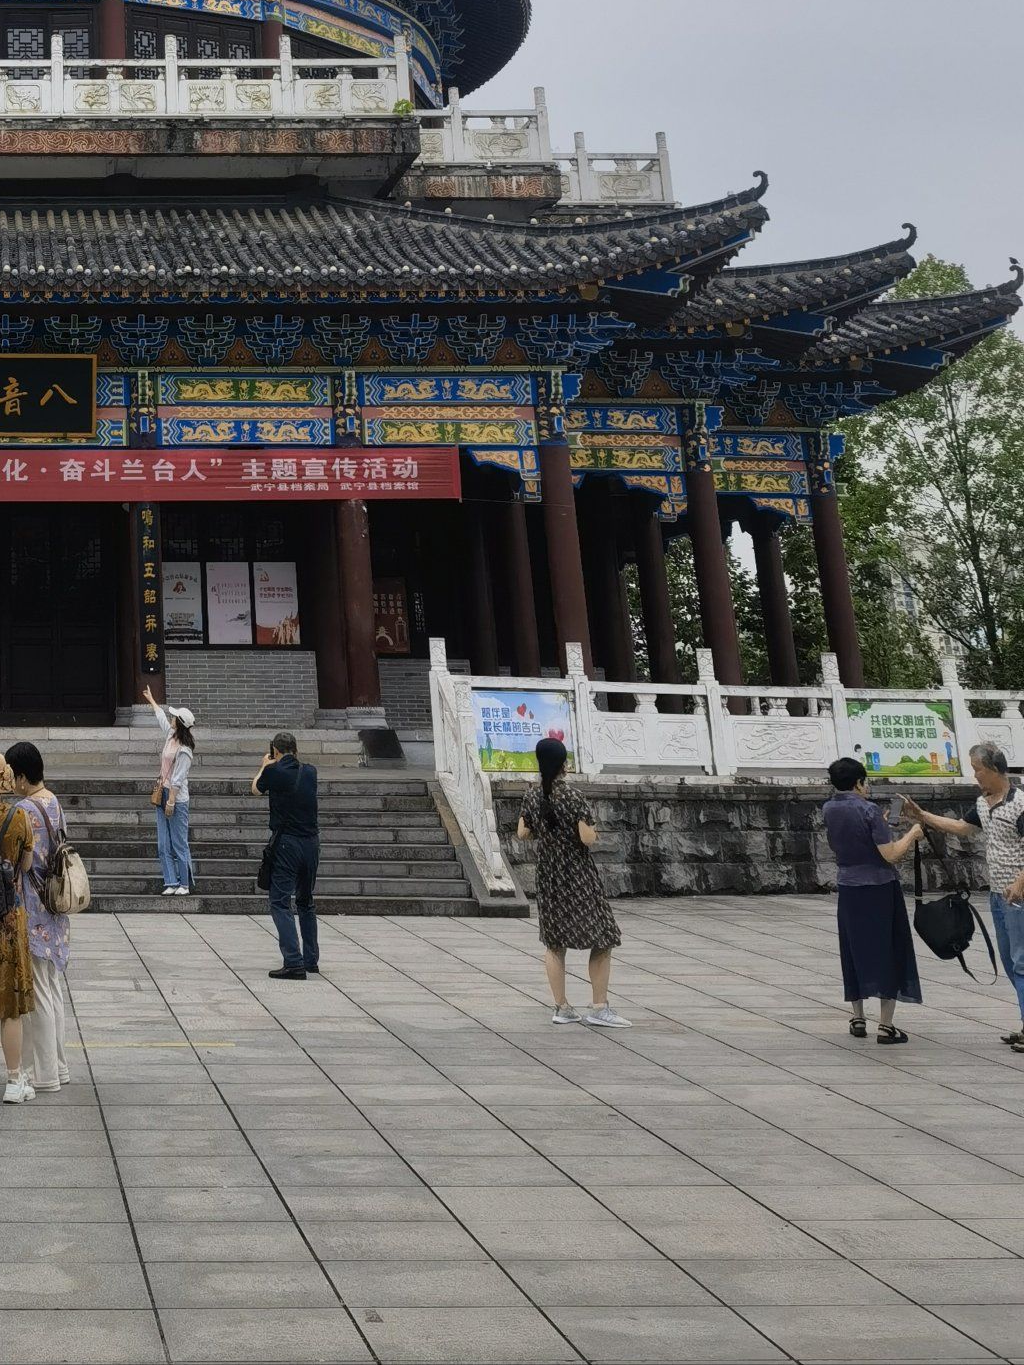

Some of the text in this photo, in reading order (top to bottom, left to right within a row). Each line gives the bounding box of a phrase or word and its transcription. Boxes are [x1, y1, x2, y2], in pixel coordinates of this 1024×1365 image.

[241, 457, 419, 481] 主题宣传活动
[340, 482, 420, 491] 武宁县档案馆
[481, 707, 511, 719] 陪伴是
[871, 715, 936, 726] 共创文明城市
[483, 721, 541, 733] 最长情的告白
[872, 728, 938, 739] 建设美好家园
